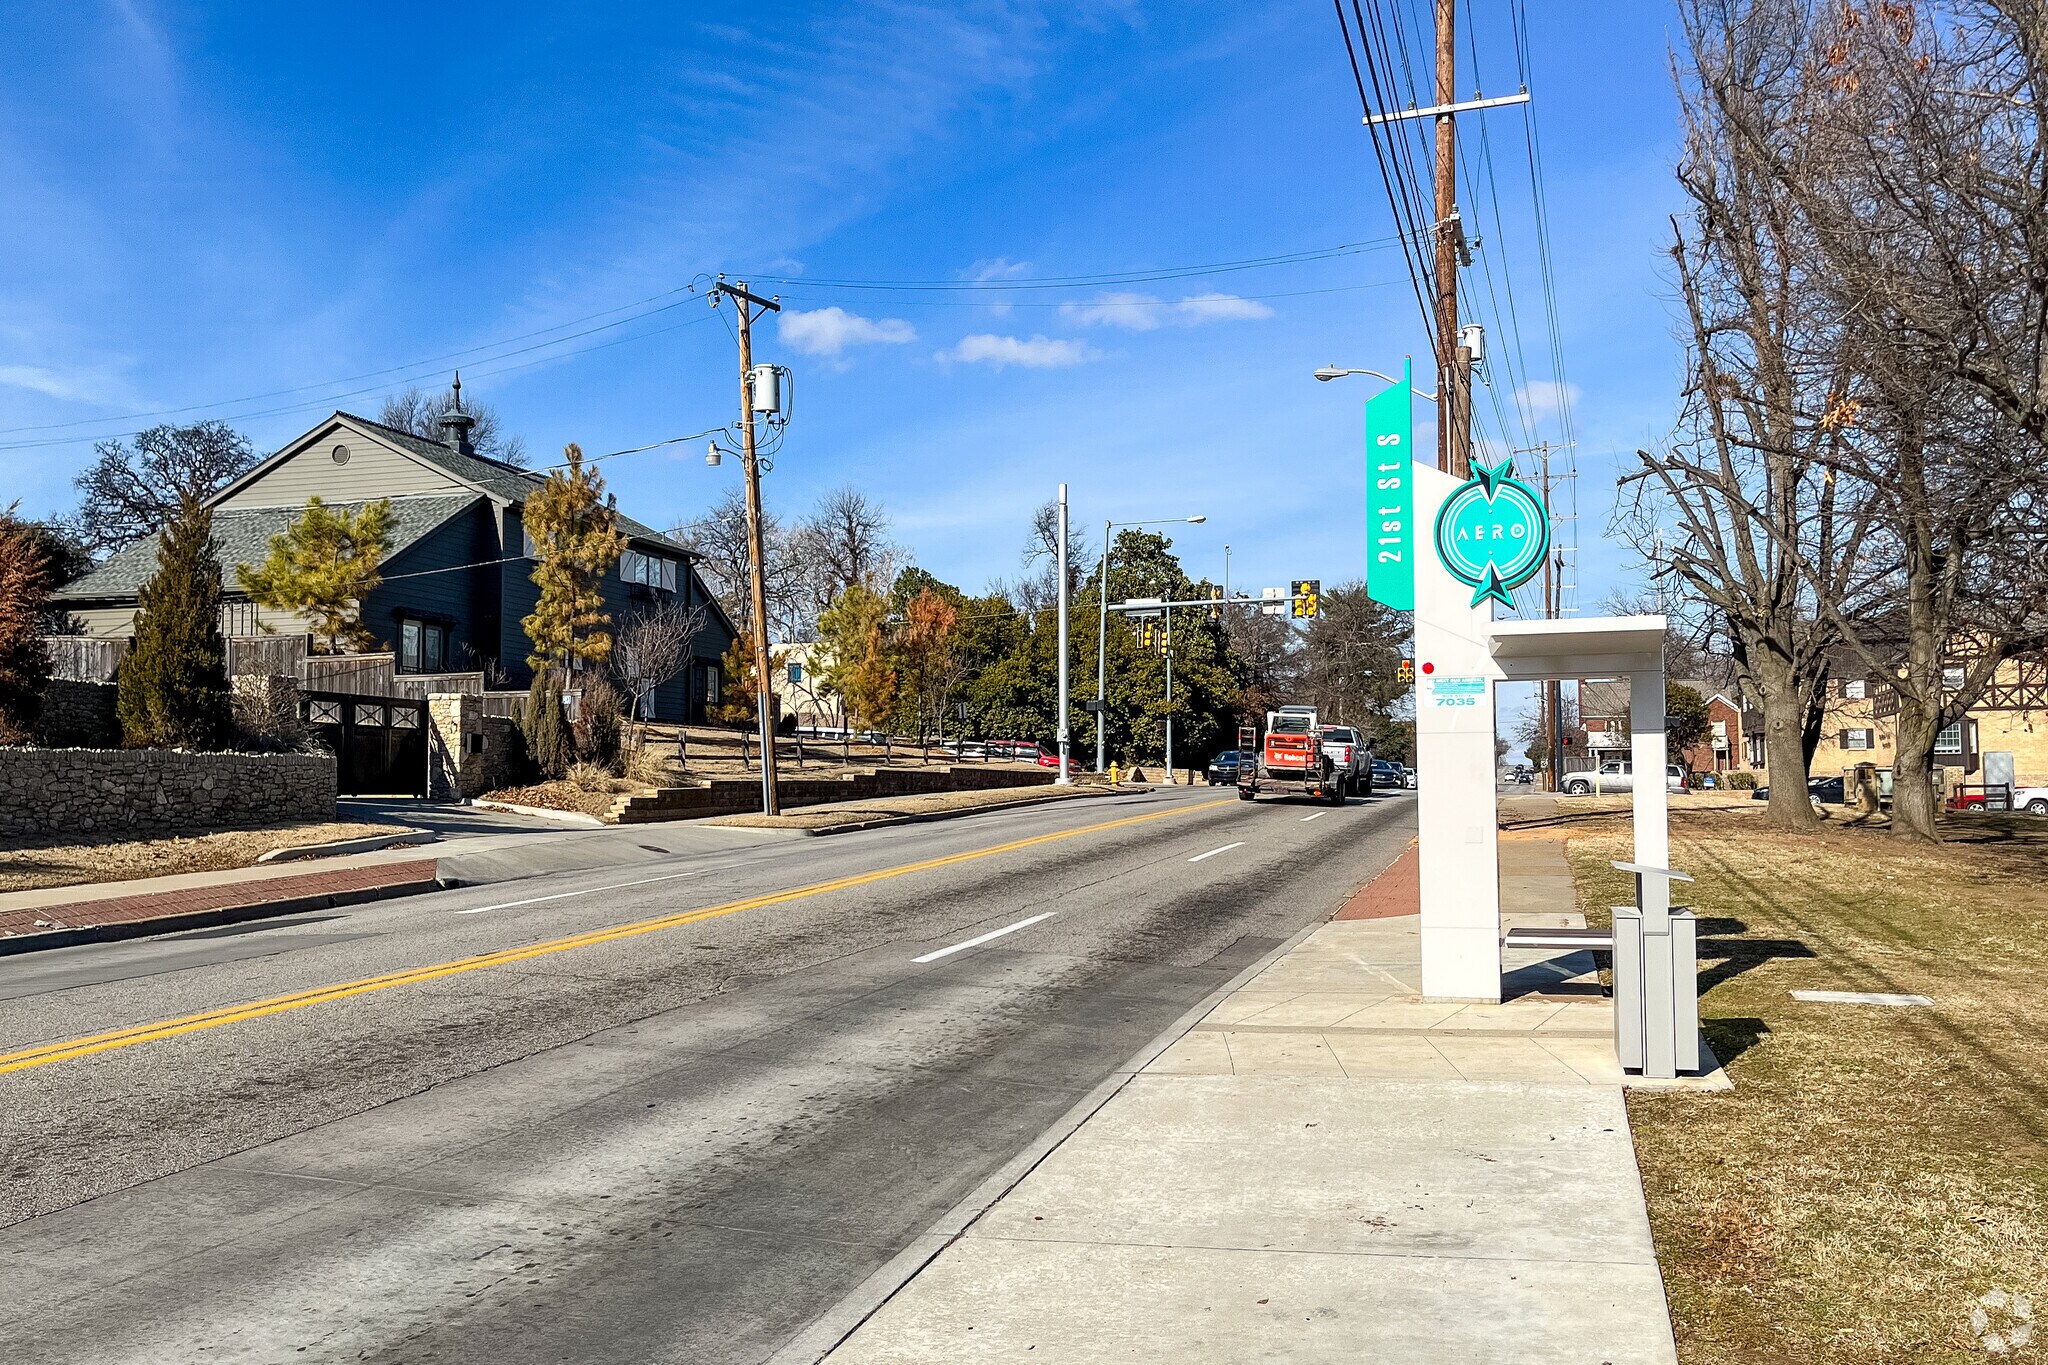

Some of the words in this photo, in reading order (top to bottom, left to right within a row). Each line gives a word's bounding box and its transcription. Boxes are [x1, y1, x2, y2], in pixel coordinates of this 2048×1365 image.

[1376, 433, 1400, 446] S
[1377, 461, 1400, 490] St
[1378, 505, 1401, 563] 21st
[1456, 523, 1526, 542] AERO
[1436, 697, 1476, 706] 7035
[1283, 753, 1306, 761] Bobcat
